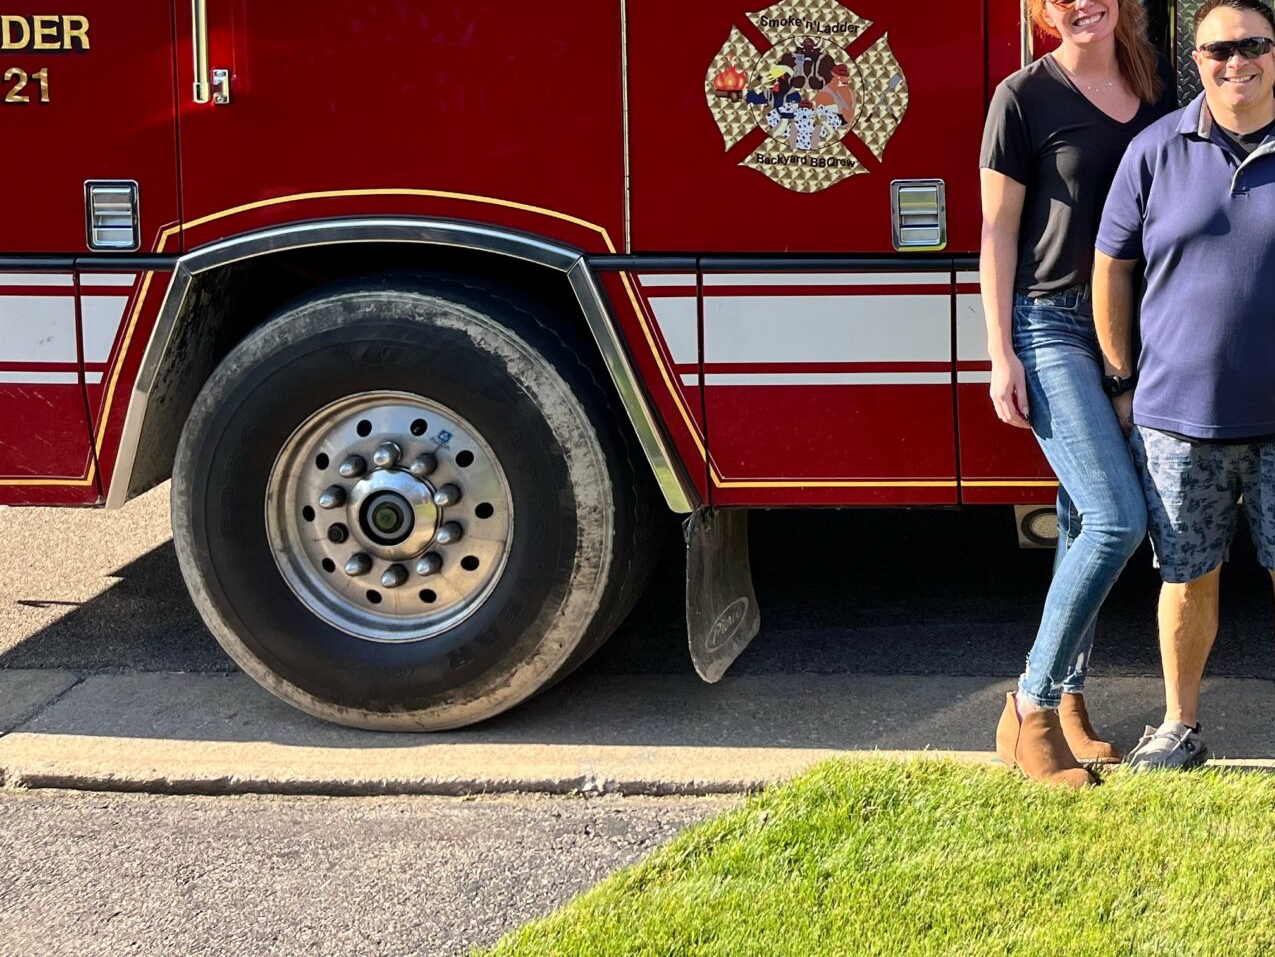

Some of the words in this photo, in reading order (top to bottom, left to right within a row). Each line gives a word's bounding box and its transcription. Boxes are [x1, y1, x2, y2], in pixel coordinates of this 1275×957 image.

[1, 15, 90, 49] DER
[4, 67, 50, 102] 21
[756, 153, 807, 165] Backyard
[810, 156, 855, 168] BBQrew
